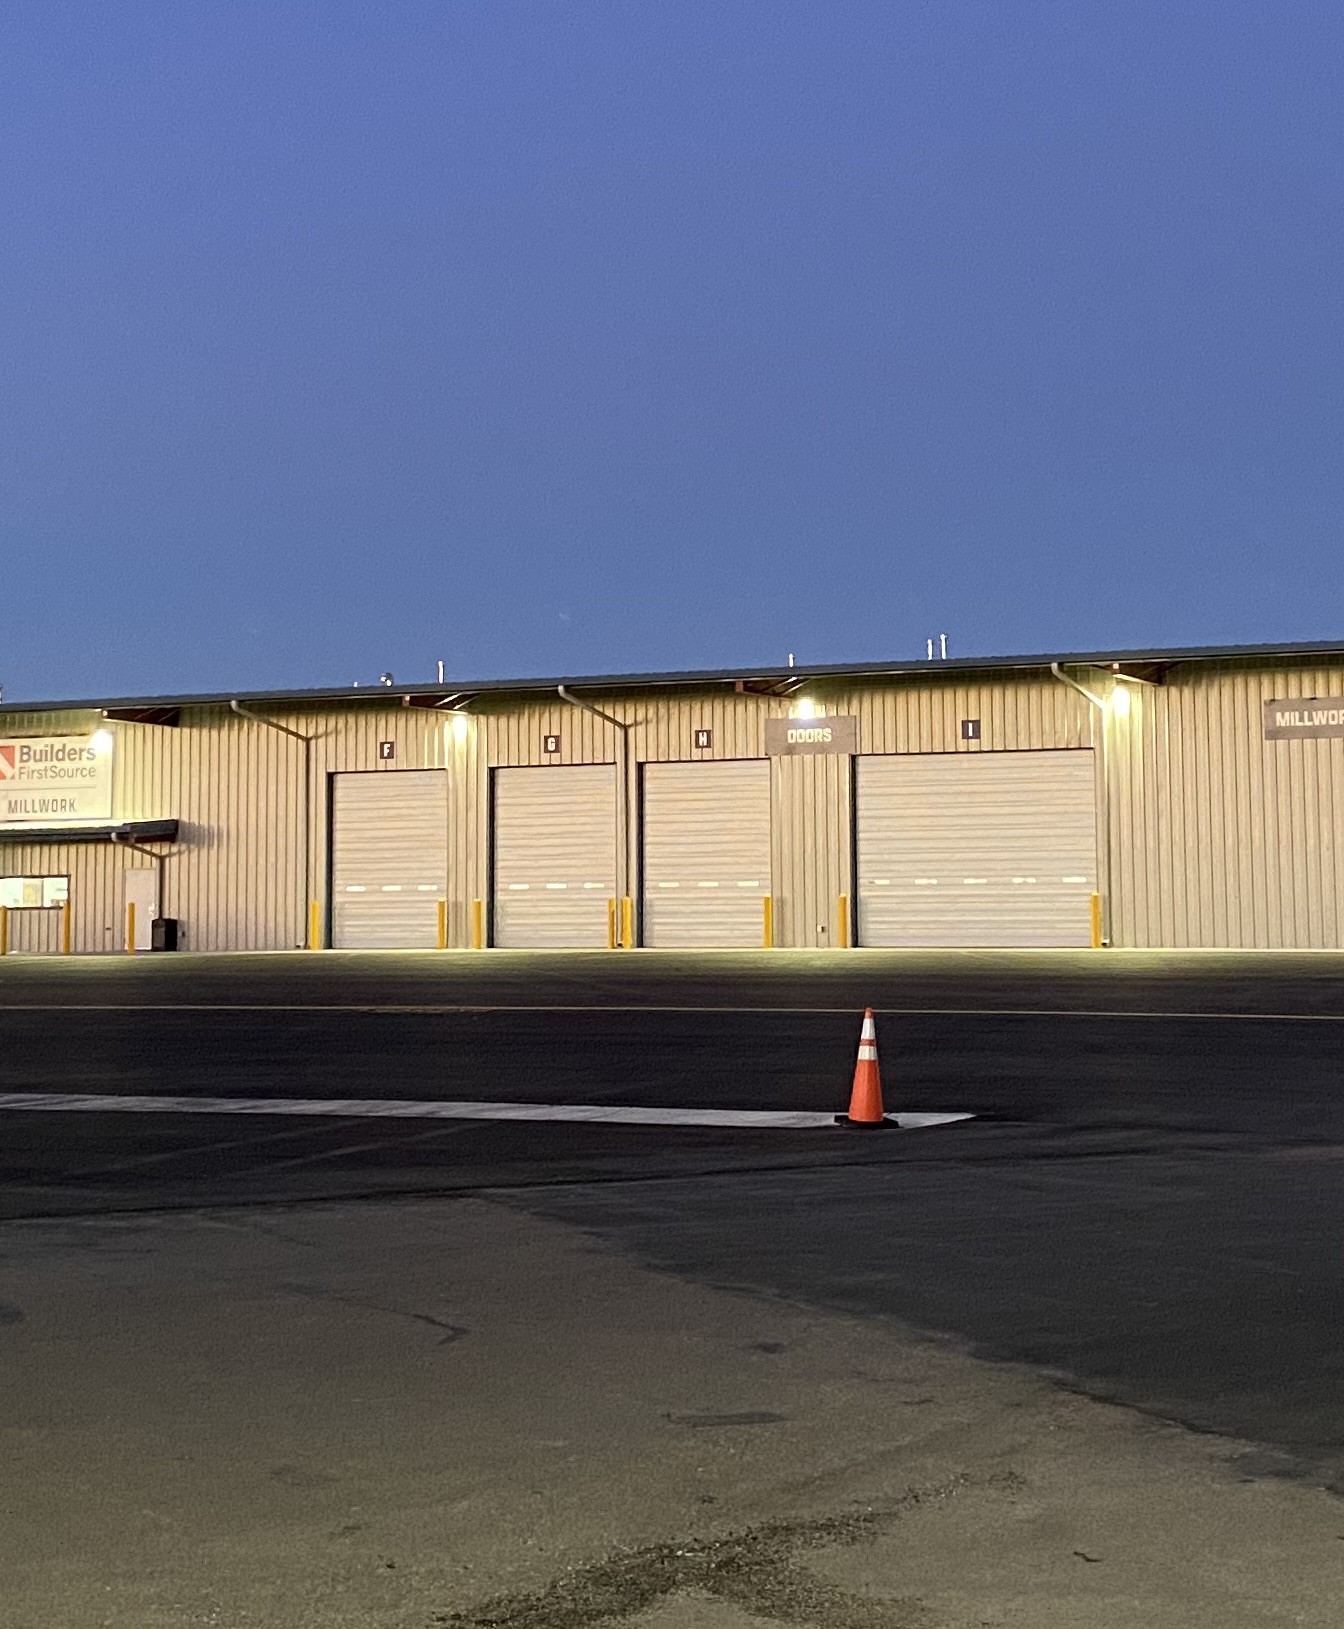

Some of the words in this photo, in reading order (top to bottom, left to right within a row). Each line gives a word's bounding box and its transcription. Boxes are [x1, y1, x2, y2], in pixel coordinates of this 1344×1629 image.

[698, 731, 707, 746] H
[787, 727, 832, 743] DOORS
[19, 743, 96, 763] Builders
[383, 743, 391, 757] F
[18, 765, 96, 780] FirstSource
[7, 798, 77, 814] MILLWORK
